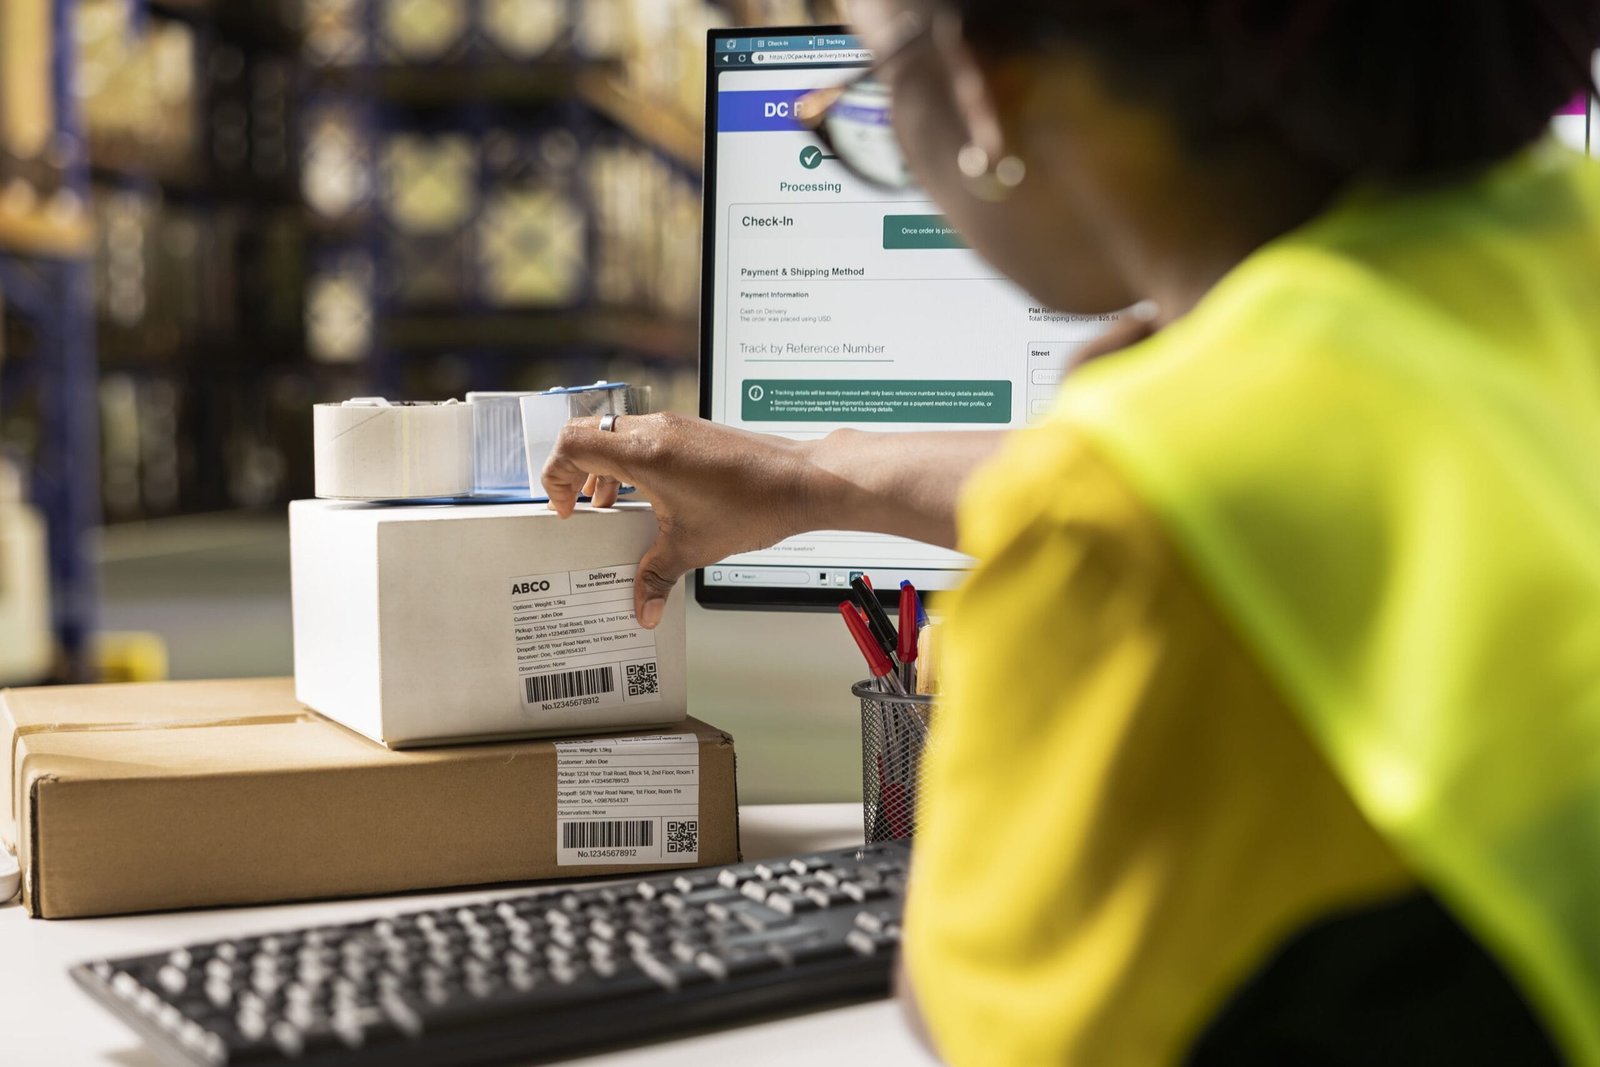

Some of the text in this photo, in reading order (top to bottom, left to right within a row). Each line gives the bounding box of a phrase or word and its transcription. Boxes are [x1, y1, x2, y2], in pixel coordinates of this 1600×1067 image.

[764, 102, 788, 117] DC
[780, 181, 842, 193] Processing
[742, 215, 793, 227] Check-In
[741, 268, 778, 278] Payment
[790, 268, 829, 277] Shipping
[832, 268, 864, 276] Method
[740, 343, 885, 355] Track by Reference Number
[589, 571, 616, 580] Delivery
[512, 580, 550, 595] ABCO
[519, 664, 551, 672] Observations:
[542, 696, 600, 711] No.12345678912
[578, 849, 637, 858] No.12345678912
